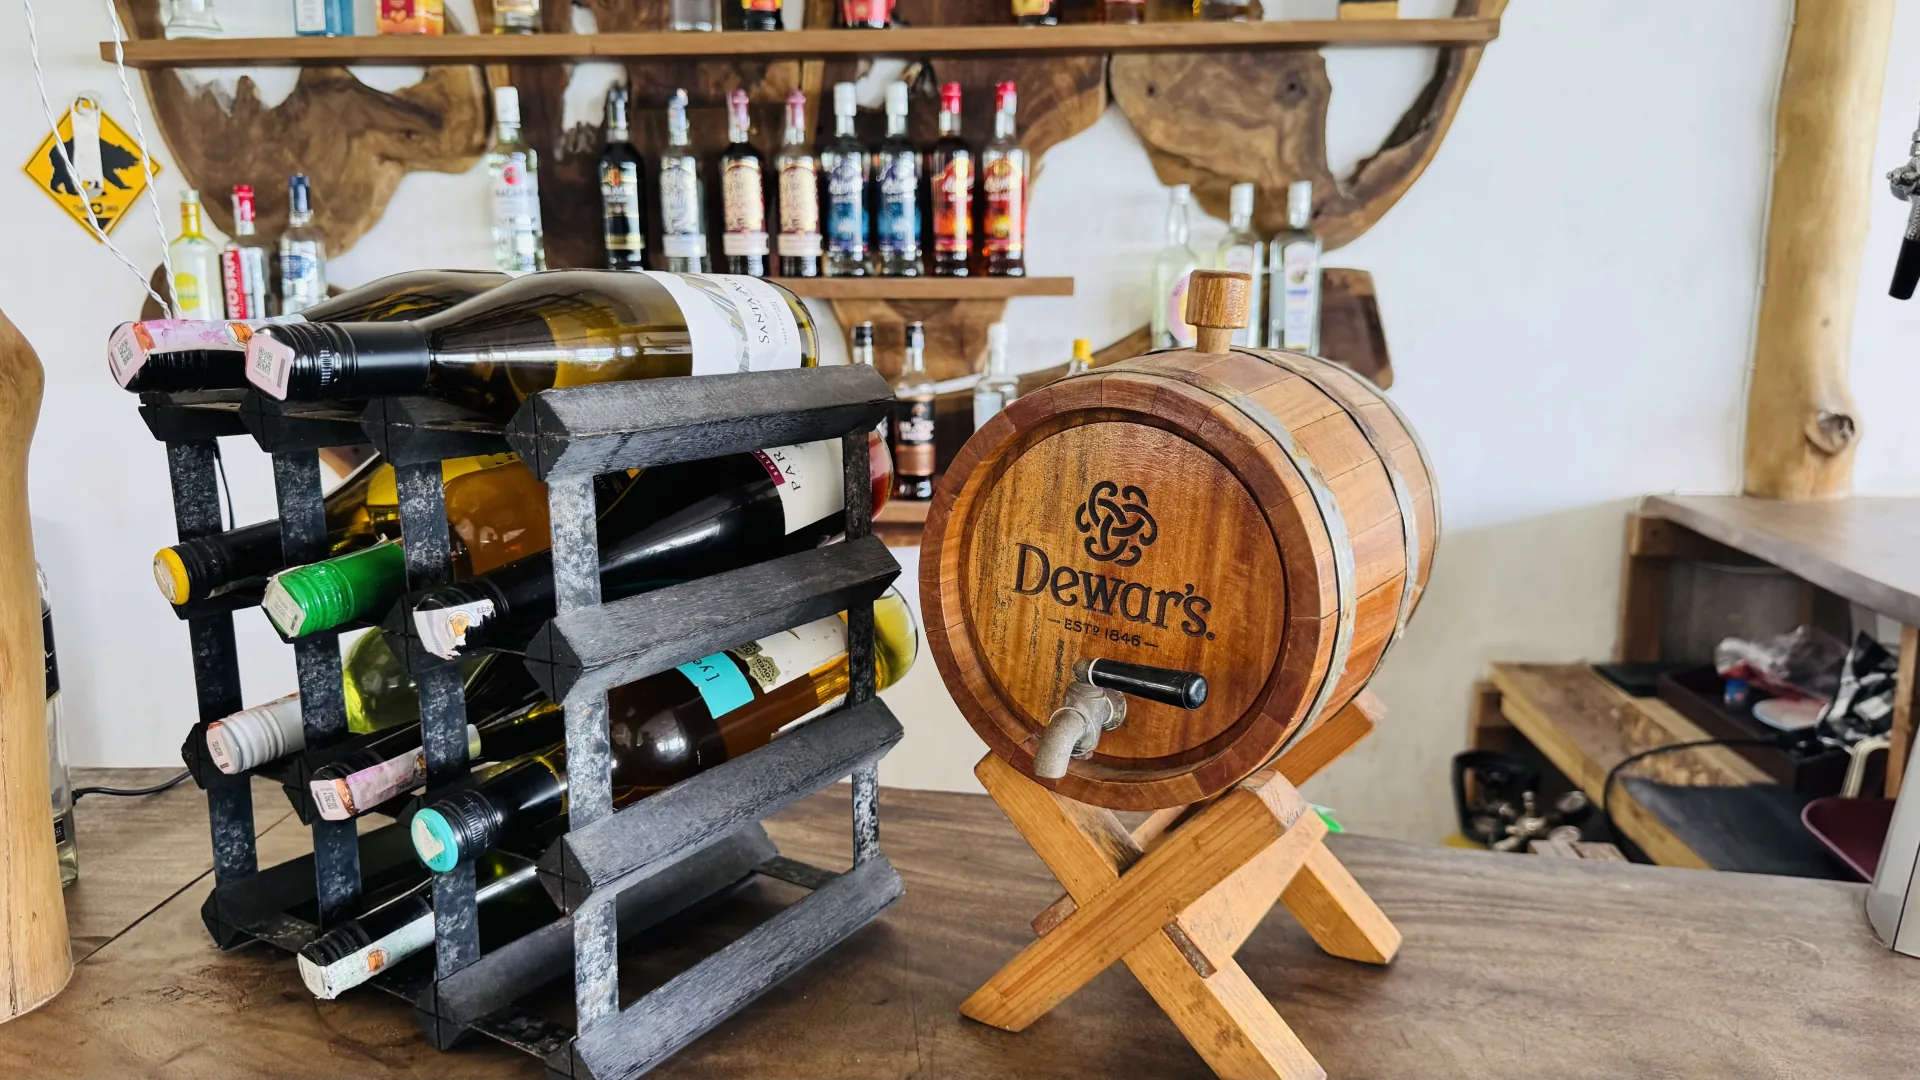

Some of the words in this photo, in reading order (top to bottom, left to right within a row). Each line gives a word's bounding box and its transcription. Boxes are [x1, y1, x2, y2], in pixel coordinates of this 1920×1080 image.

[747, 297, 770, 344] SANTA
[1105, 627, 1142, 647] 1846
[756, 658, 773, 682] LOVED
